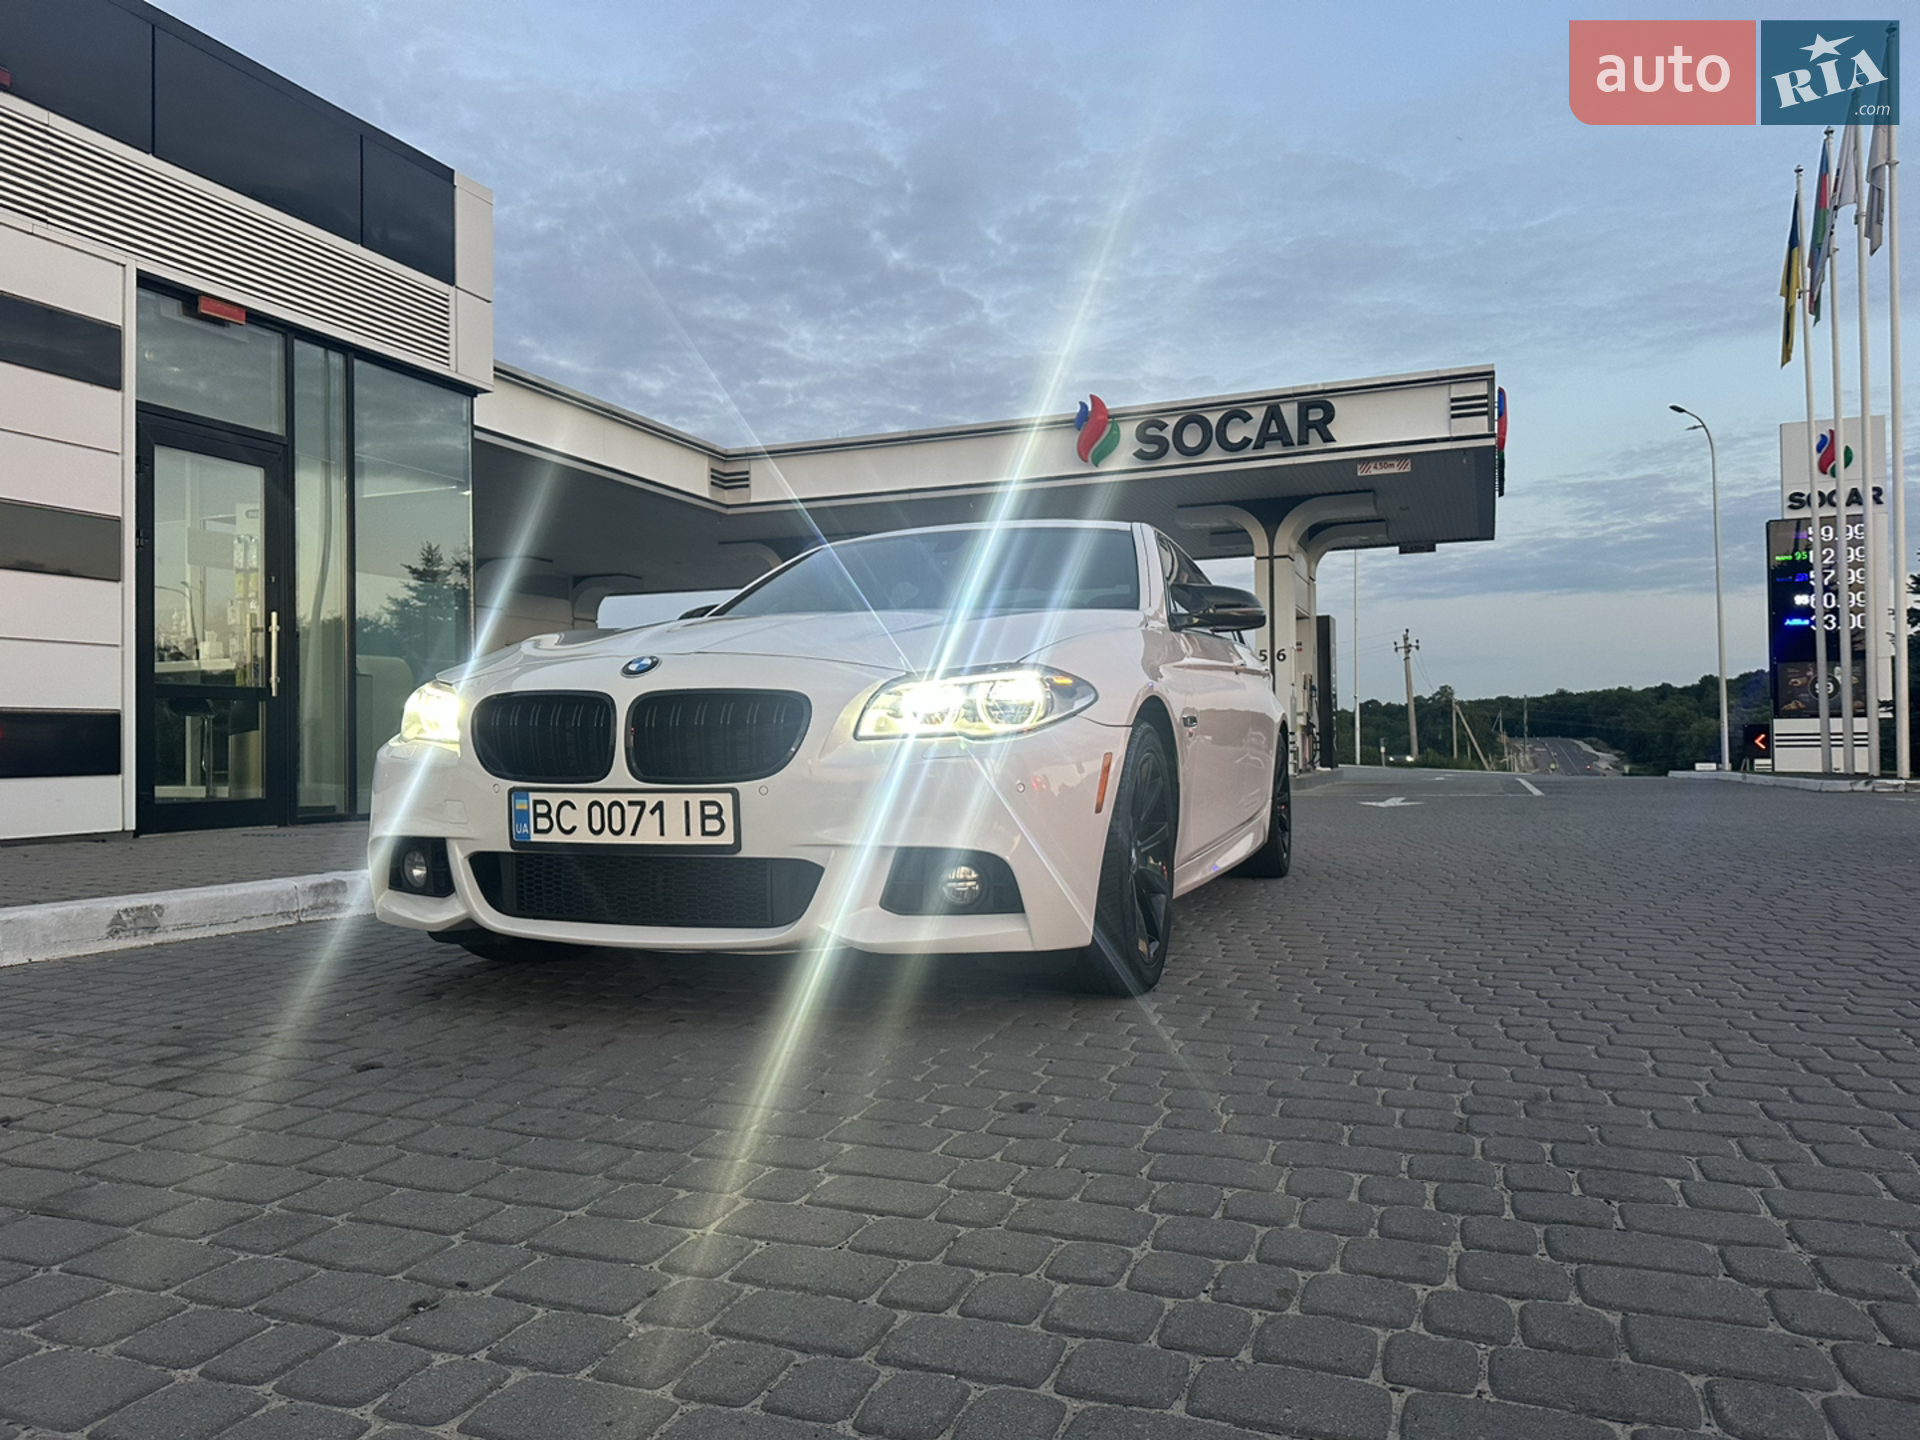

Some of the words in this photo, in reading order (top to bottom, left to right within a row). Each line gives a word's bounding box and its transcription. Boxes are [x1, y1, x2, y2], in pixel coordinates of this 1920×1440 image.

[1132, 399, 1336, 460] SOCAR
[1787, 486, 1884, 510] SOCAR
[1794, 551, 1809, 561] 95
[1809, 546, 1865, 564] 299
[1259, 649, 1268, 662] 5
[1276, 648, 1287, 662] 6
[532, 799, 578, 836] BC
[587, 800, 665, 837] 0071
[684, 800, 726, 837] IB
[515, 823, 529, 835] UA
